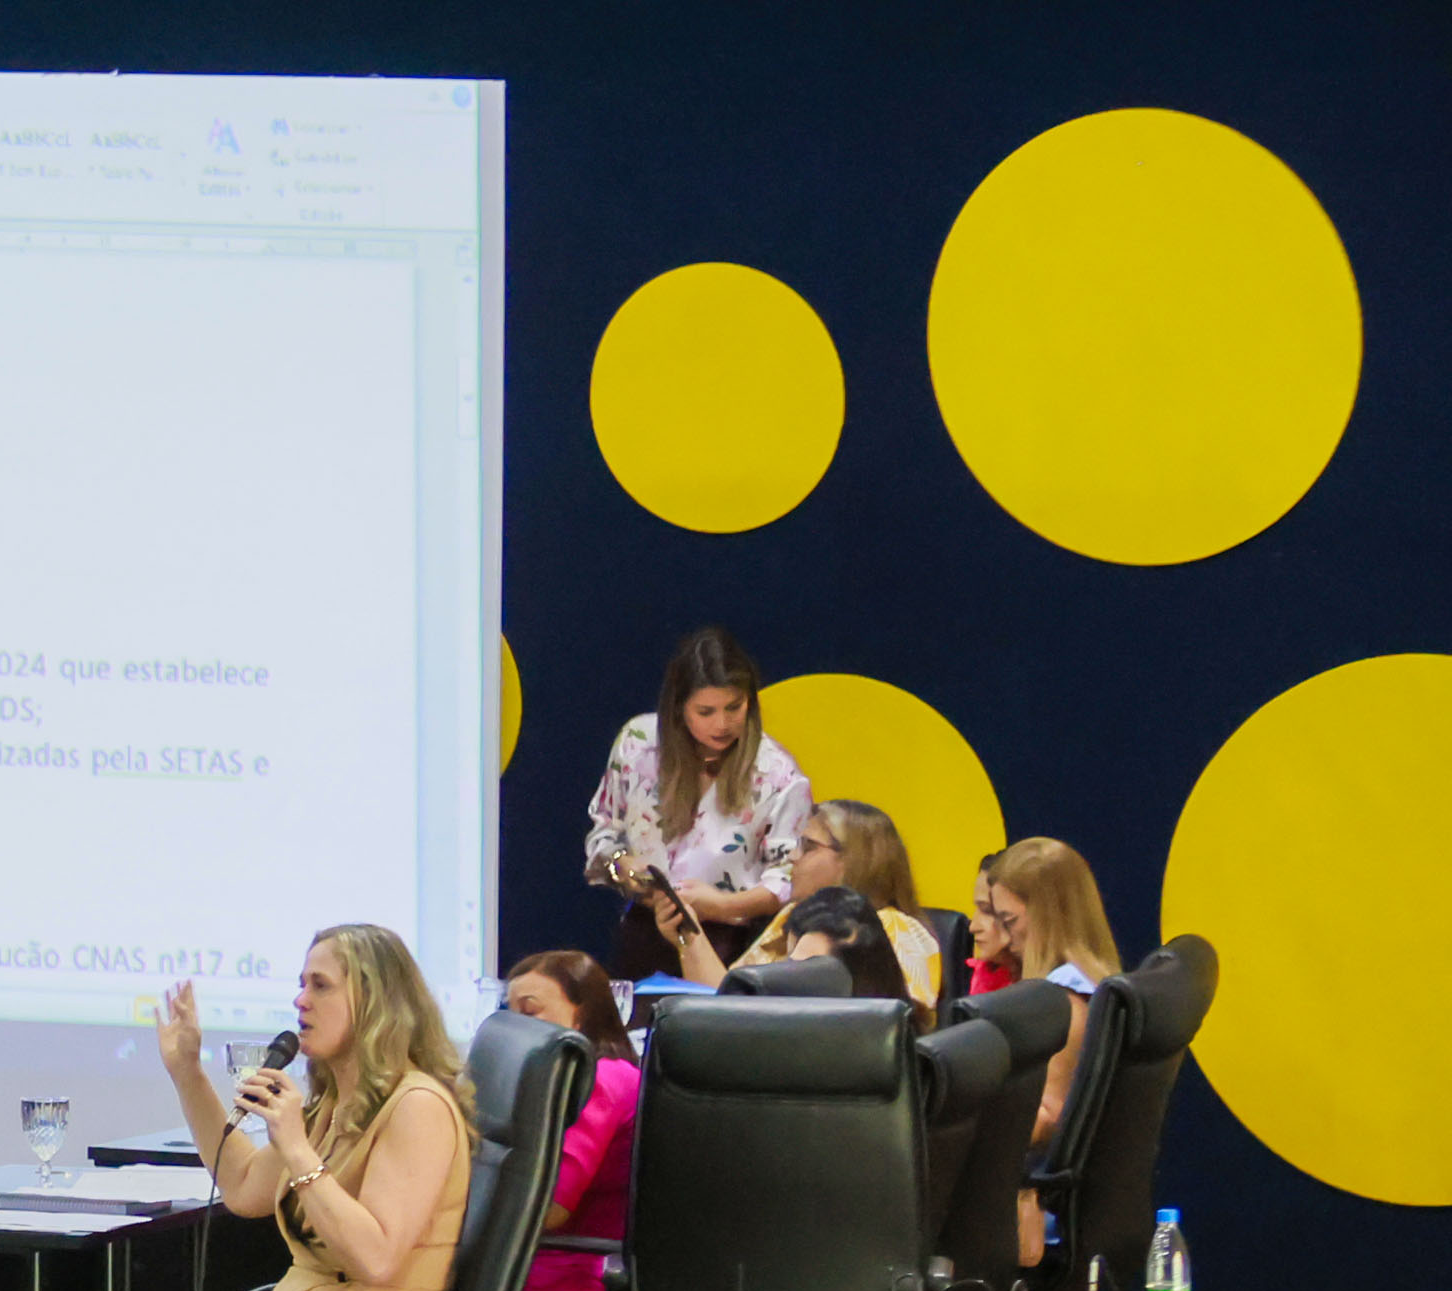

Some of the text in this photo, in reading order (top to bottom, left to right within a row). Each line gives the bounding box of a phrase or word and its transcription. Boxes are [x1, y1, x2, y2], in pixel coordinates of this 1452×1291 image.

[59, 658, 113, 688] que
[122, 658, 271, 688] estabelece
[91, 745, 149, 777] pela
[160, 747, 245, 777] SETAS
[253, 756, 271, 778] e
[69, 944, 148, 972] CNAS
[236, 952, 272, 977] de
